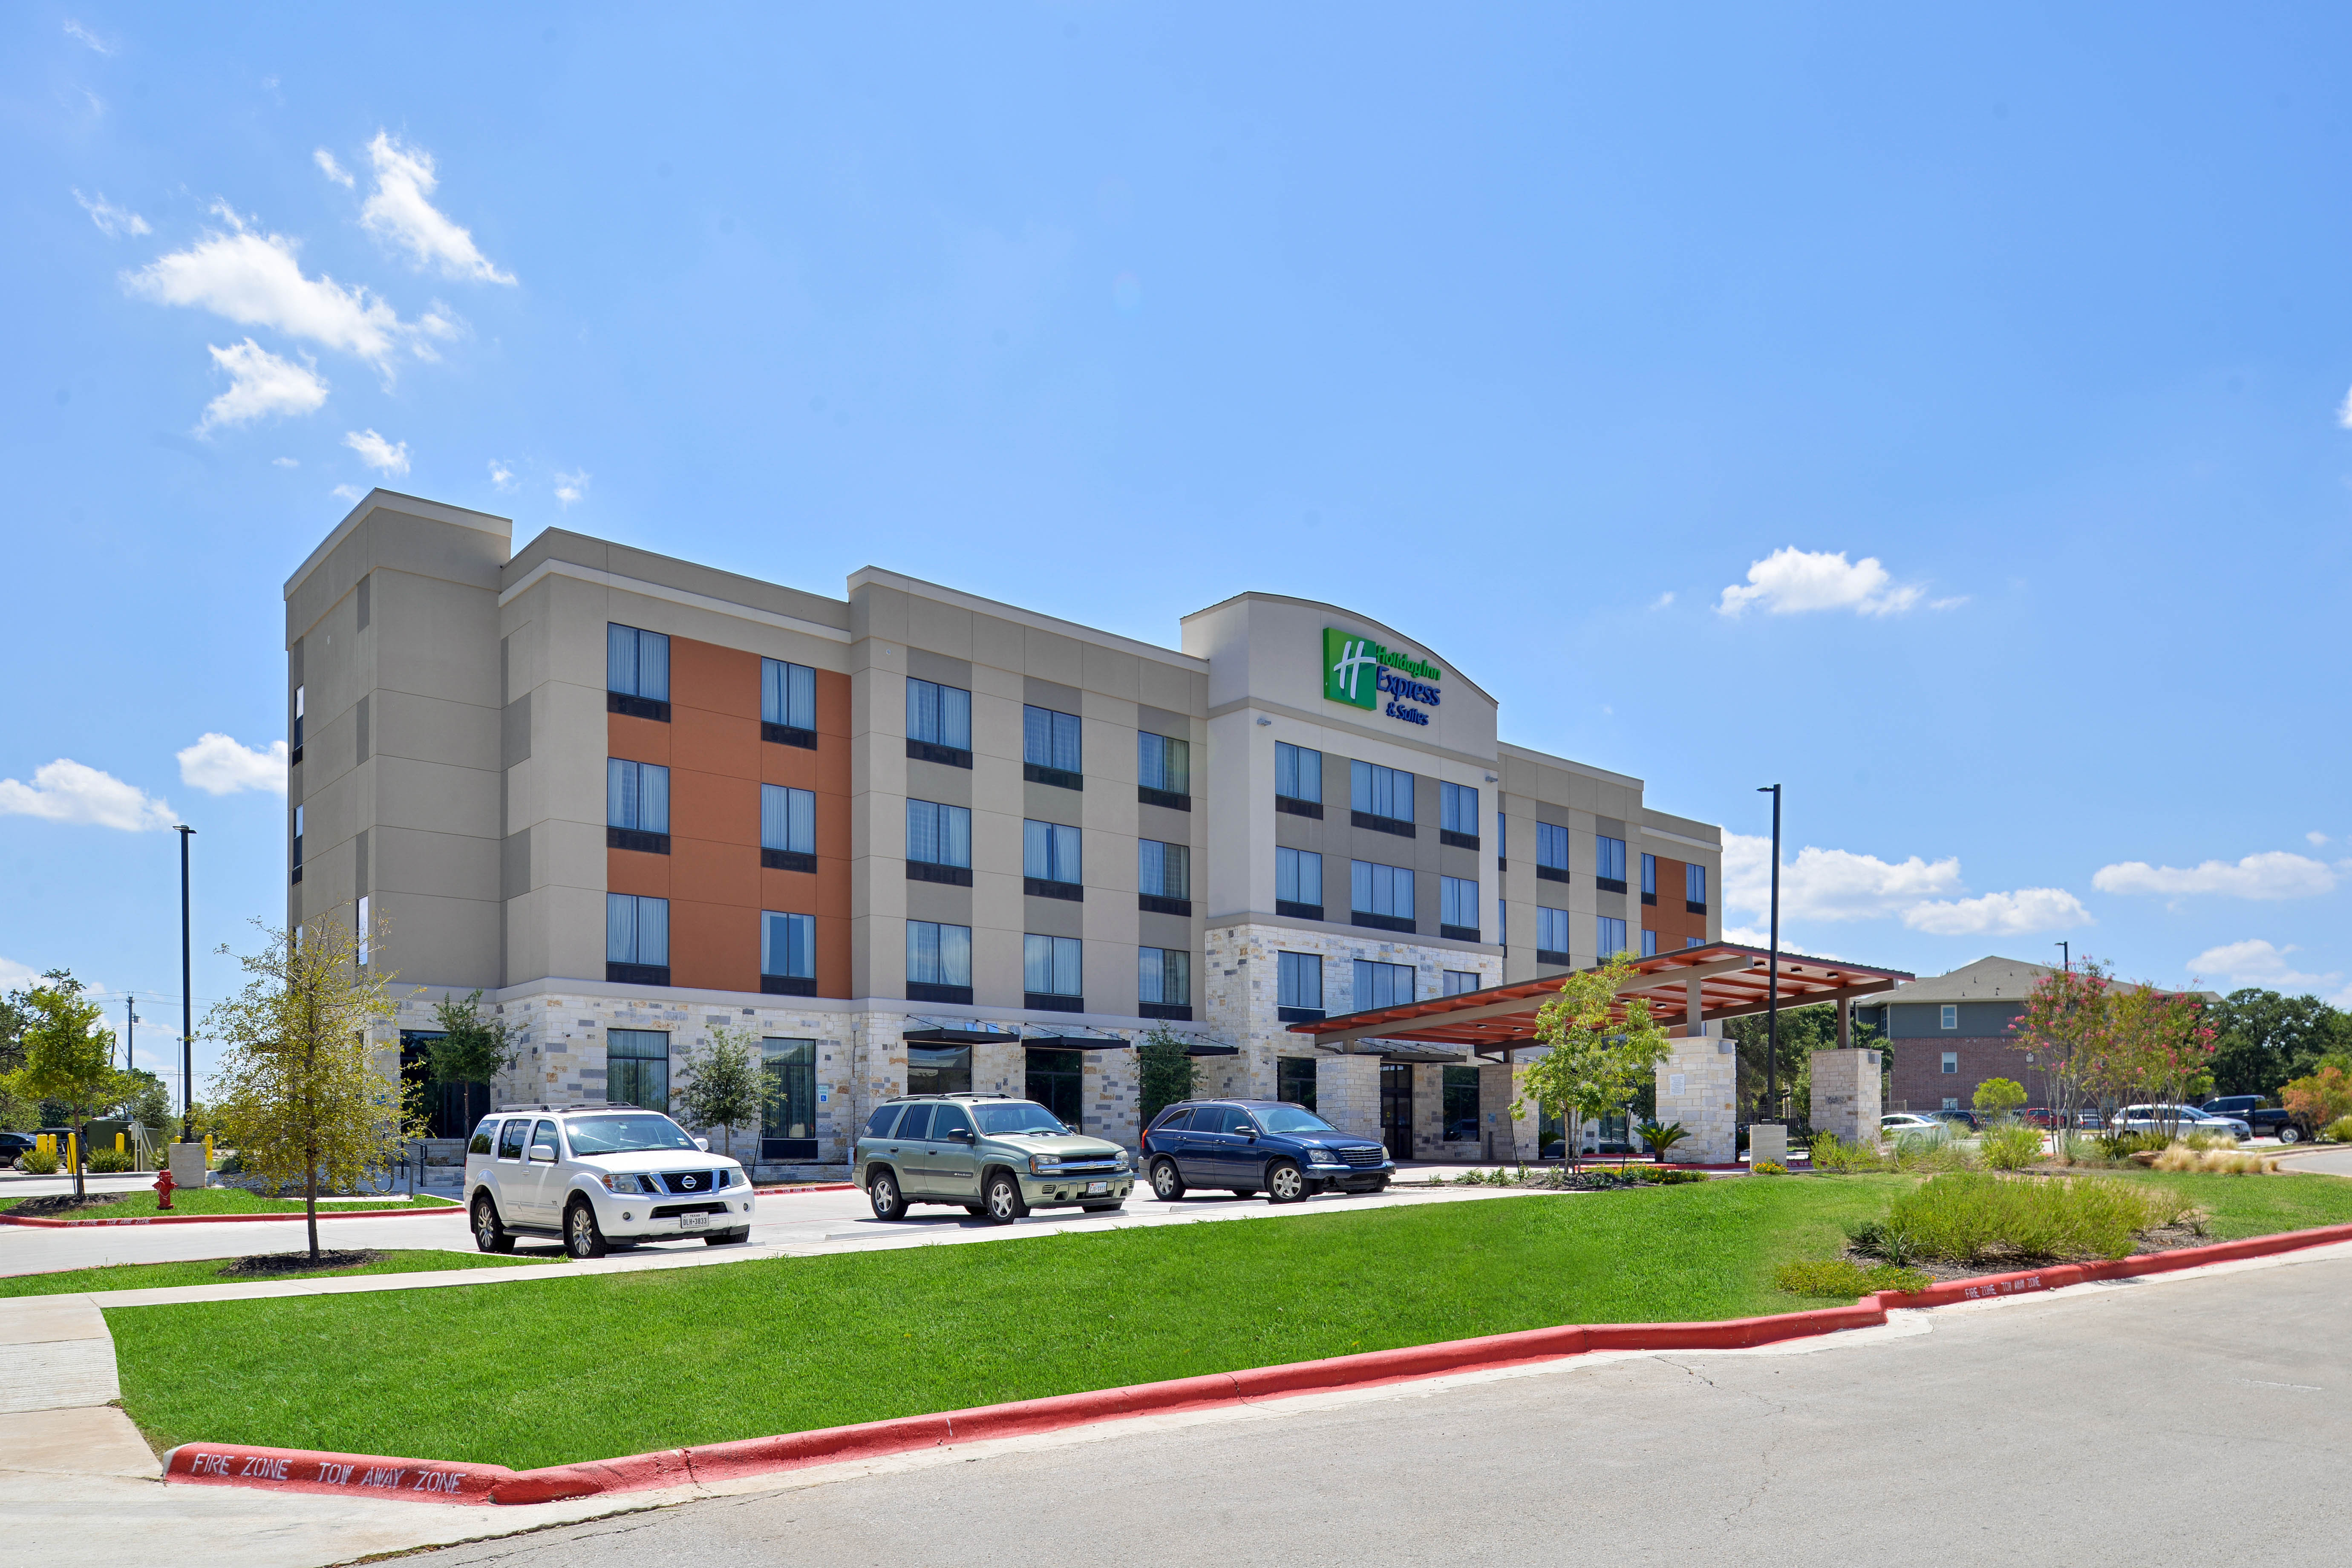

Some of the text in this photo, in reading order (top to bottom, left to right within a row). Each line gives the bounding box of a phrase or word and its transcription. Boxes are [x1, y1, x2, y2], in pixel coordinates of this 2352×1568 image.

[1376, 645, 1441, 680] Holiday Inn
[1376, 666, 1441, 706] Express
[1386, 701, 1429, 726] & Suites
[1965, 1277, 2041, 1299] FIRE ZONE TOW AWAY ZONE
[192, 1453, 467, 1494] FIRE ZONE TOW AWAY ZONE
